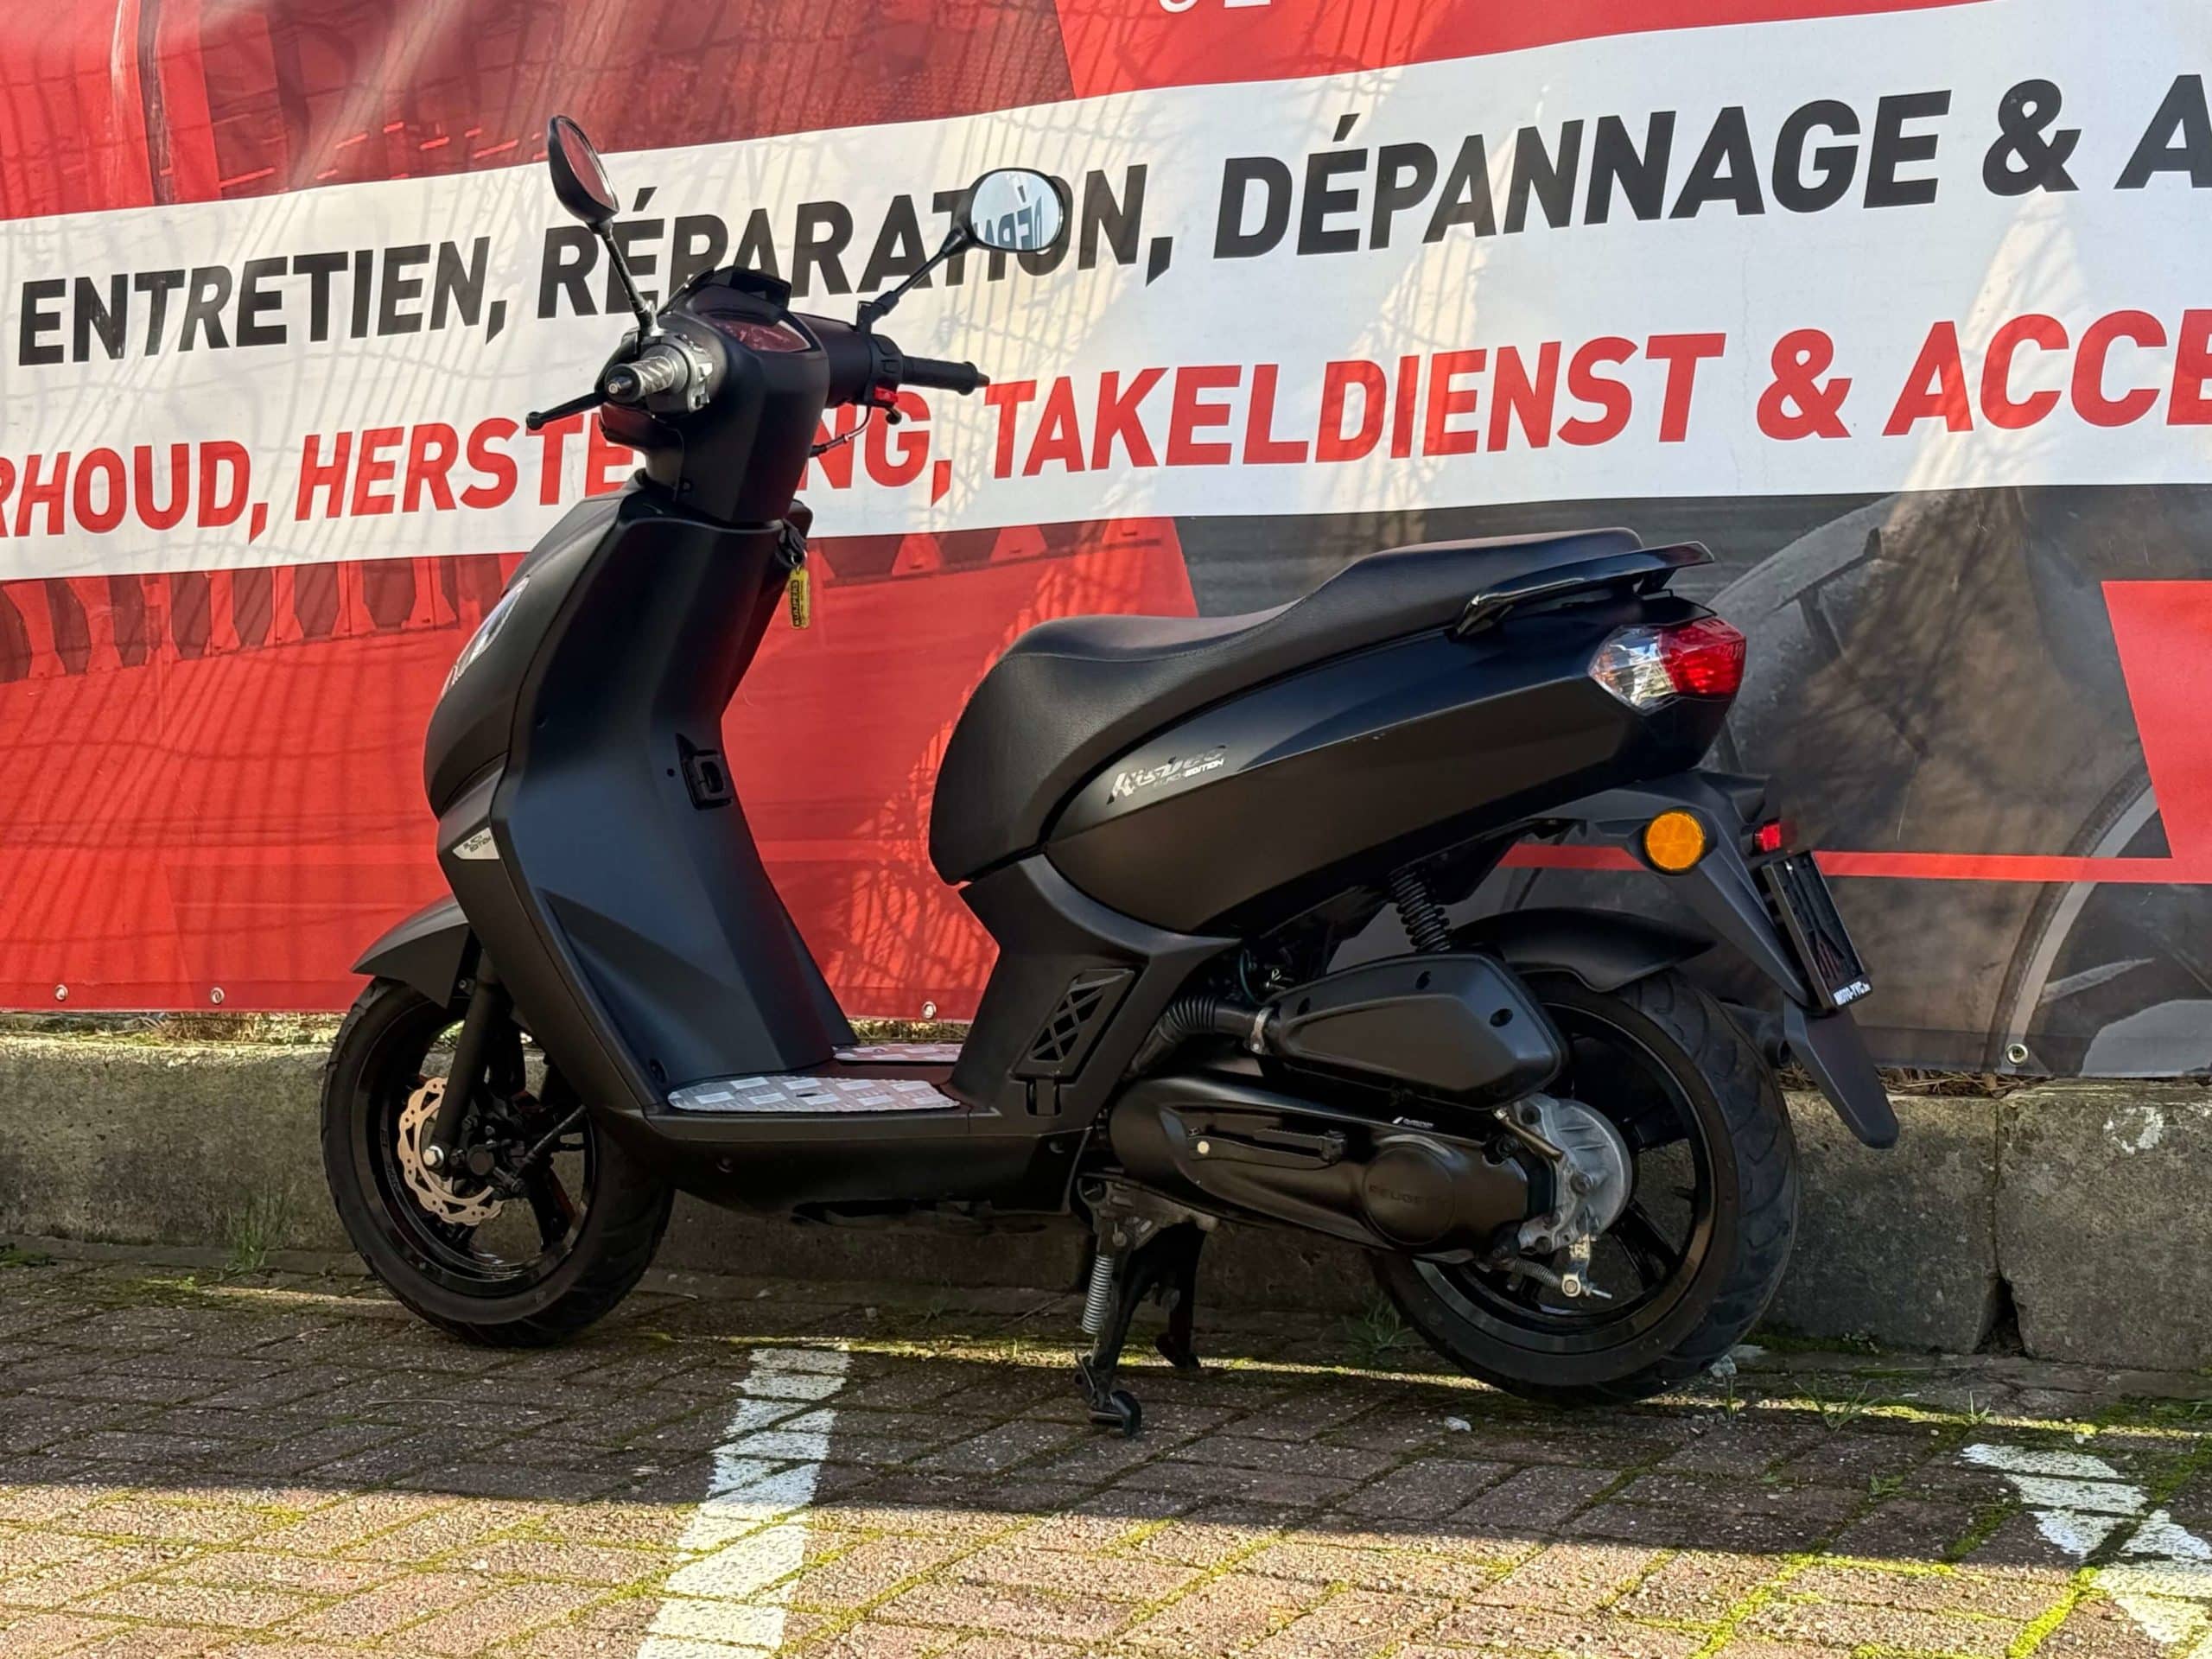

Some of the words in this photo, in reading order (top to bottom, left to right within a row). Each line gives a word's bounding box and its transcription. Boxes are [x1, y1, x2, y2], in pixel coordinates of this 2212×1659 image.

[18, 237, 507, 365] ENTRETIEN,
[537, 164, 1173, 319] RÉPARATON,
[1213, 90, 1951, 258] DÉPANNAGE
[1982, 79, 2082, 196] &
[295, 391, 951, 520] HERSTENG,
[984, 334, 1726, 479] TAKELDIENST
[1757, 329, 1852, 441] &
